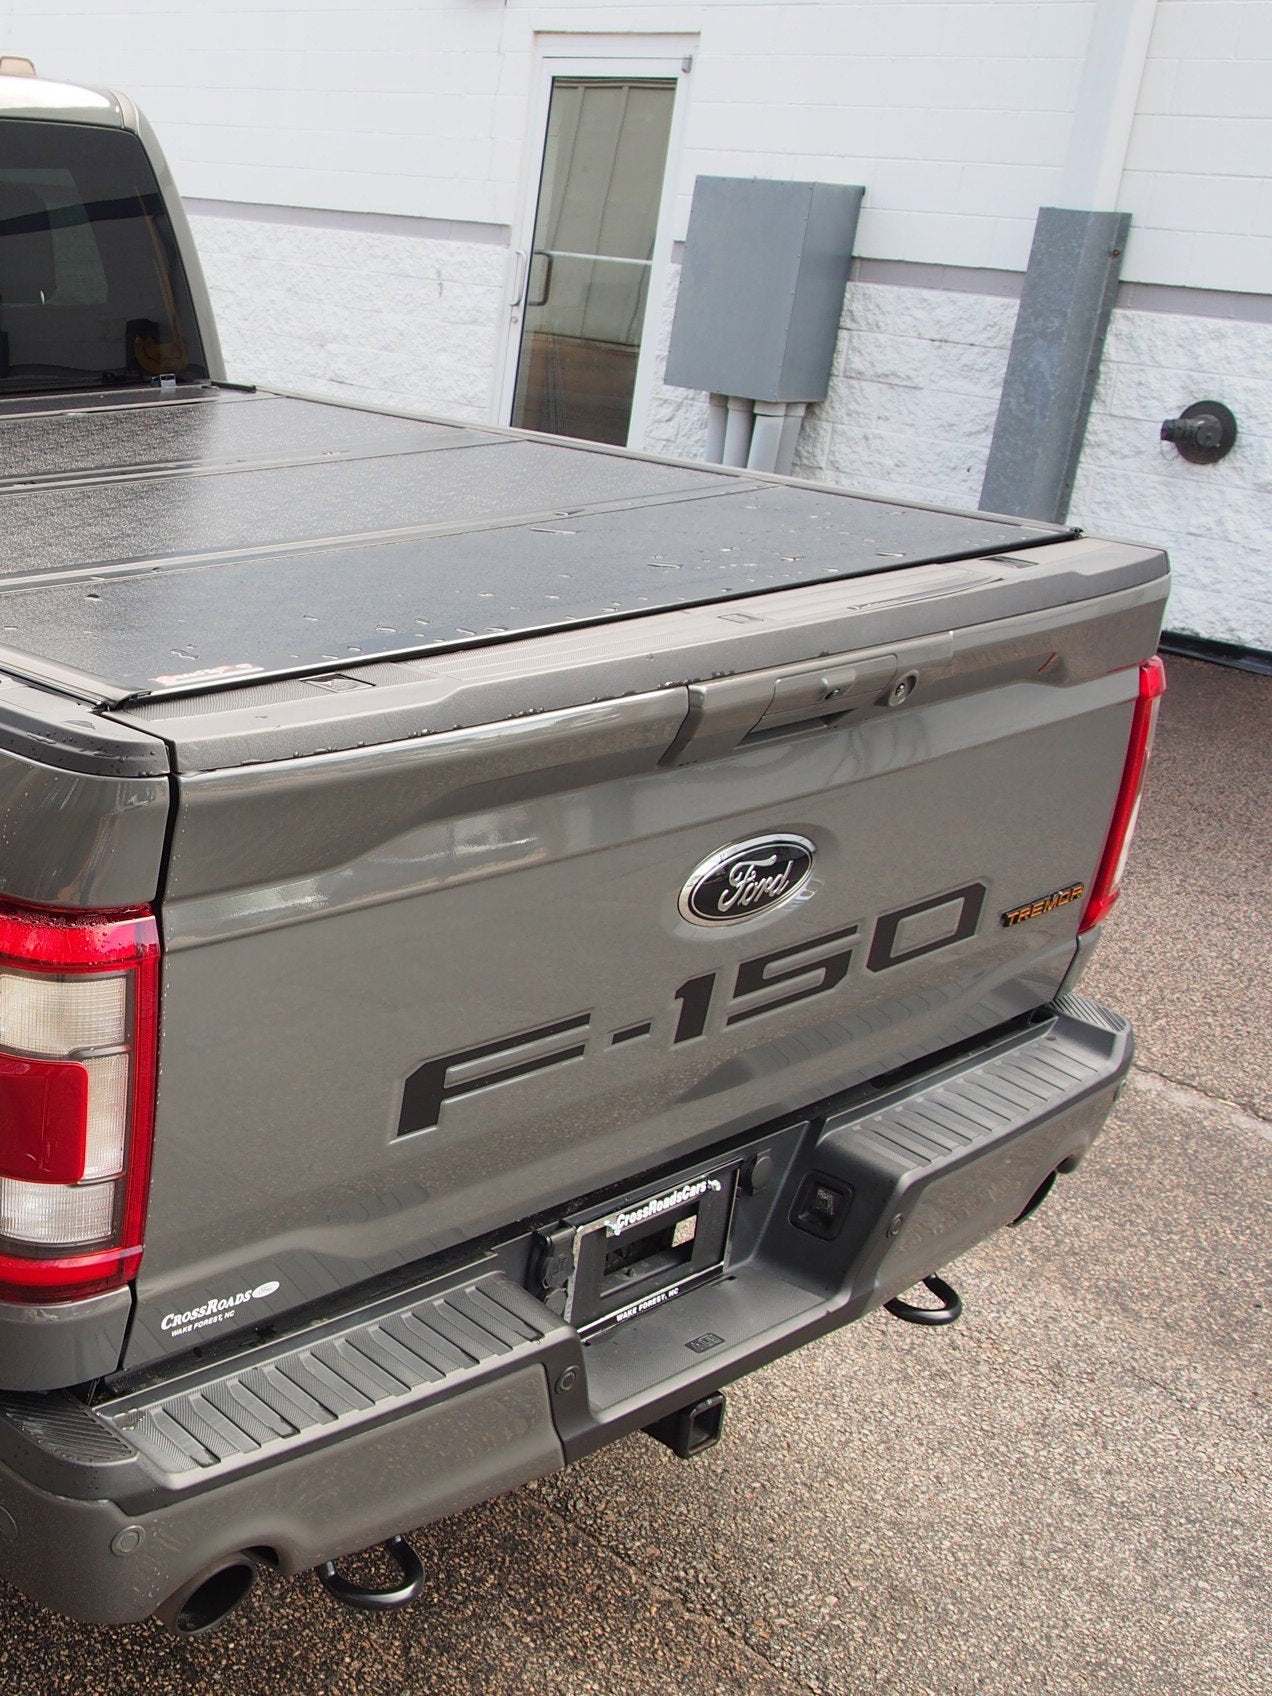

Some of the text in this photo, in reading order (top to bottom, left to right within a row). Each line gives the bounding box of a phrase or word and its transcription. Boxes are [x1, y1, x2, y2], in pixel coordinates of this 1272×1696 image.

[718, 854, 794, 912] Ford
[1007, 885, 1085, 927] TREMOR
[394, 881, 987, 1139] F-150
[616, 1181, 707, 1229] CrossRoadsCars
[171, 1324, 193, 1337] WAKE
[224, 1310, 236, 1320] NC
[616, 1307, 638, 1322] WAKE
[668, 1288, 680, 1298] NC
